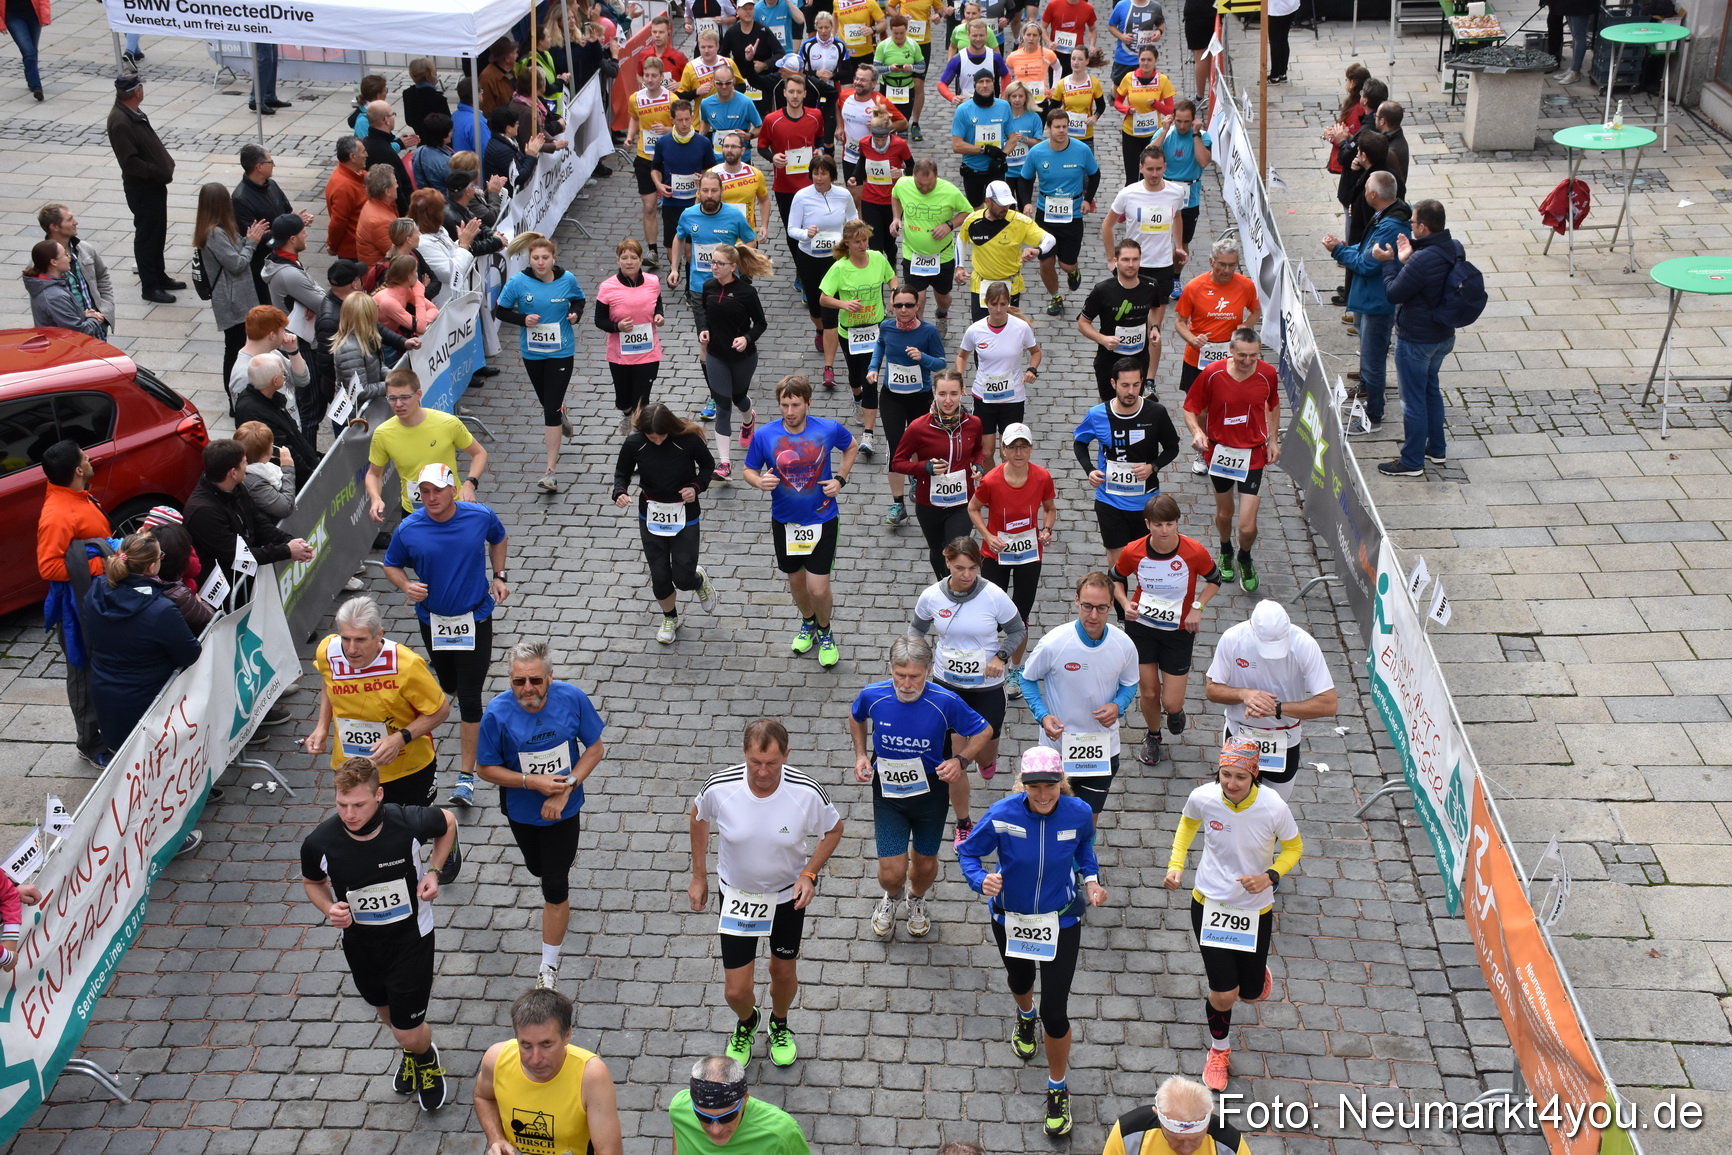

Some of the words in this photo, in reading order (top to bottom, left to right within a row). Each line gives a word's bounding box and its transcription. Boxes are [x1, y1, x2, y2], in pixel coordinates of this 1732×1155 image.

[124, 0, 170, 12] BMW
[176, 0, 315, 22] ConnectedDrive
[126, 13, 181, 29] Vernetzt,
[183, 21, 203, 29] um
[205, 19, 225, 31] frei
[227, 24, 241, 32] zu
[244, 24, 273, 34] sein.
[908, 25, 921, 34] 267
[1057, 38, 1073, 46] 2018
[891, 88, 904, 96] 154
[638, 107, 653, 115] MAX
[1136, 118, 1155, 128] 2635
[981, 132, 996, 141] 118
[796, 155, 802, 163] 7
[870, 168, 885, 176] 124
[675, 181, 695, 190] 2558
[737, 178, 758, 187] BÖGL
[1048, 205, 1069, 214] 2119
[1150, 214, 1163, 224] 40
[815, 240, 837, 249] 2561
[915, 256, 936, 267] 2090
[531, 331, 556, 342] 2514
[624, 332, 649, 344] 2084
[852, 332, 876, 343] 2203
[1119, 333, 1142, 345] 2369
[1204, 350, 1228, 361] 2385
[892, 372, 917, 384] 2916
[985, 380, 1009, 392] 2607
[333, 400, 347, 419] swn
[1216, 455, 1244, 468] 2317
[1111, 471, 1138, 484] 2191
[935, 481, 962, 495] 2006
[651, 511, 678, 523] 2311
[793, 528, 814, 542] 239
[1003, 539, 1032, 553] 2408
[207, 580, 222, 601] swn
[1142, 605, 1175, 622] 2243
[1436, 596, 1447, 618] swn
[437, 623, 470, 636] 2149
[948, 659, 980, 674] 2532
[266, 678, 281, 700] GmbH
[332, 684, 360, 695] MAX
[363, 679, 400, 692] BÖGL
[345, 730, 382, 745] 2638
[531, 730, 557, 742] ERTEL
[881, 734, 931, 748] SYSCAD
[1068, 745, 1104, 760] 2285
[528, 756, 563, 775] 2751
[883, 769, 919, 783] 2466
[11, 845, 37, 873] swn
[58, 812, 110, 917] UNS
[382, 858, 406, 868] PFLEIDERER
[357, 892, 401, 911] 2313
[372, 911, 392, 919] Tobias
[729, 899, 769, 918] 2472
[737, 920, 757, 930] Werner
[1210, 911, 1251, 931] 2799
[1012, 926, 1052, 942] 2923
[20, 846, 131, 1039] EINFACH
[77, 936, 126, 1020] Service-Line:
[1524, 960, 1549, 1012] Neumarkts
[515, 1136, 555, 1149] HIRSCH
